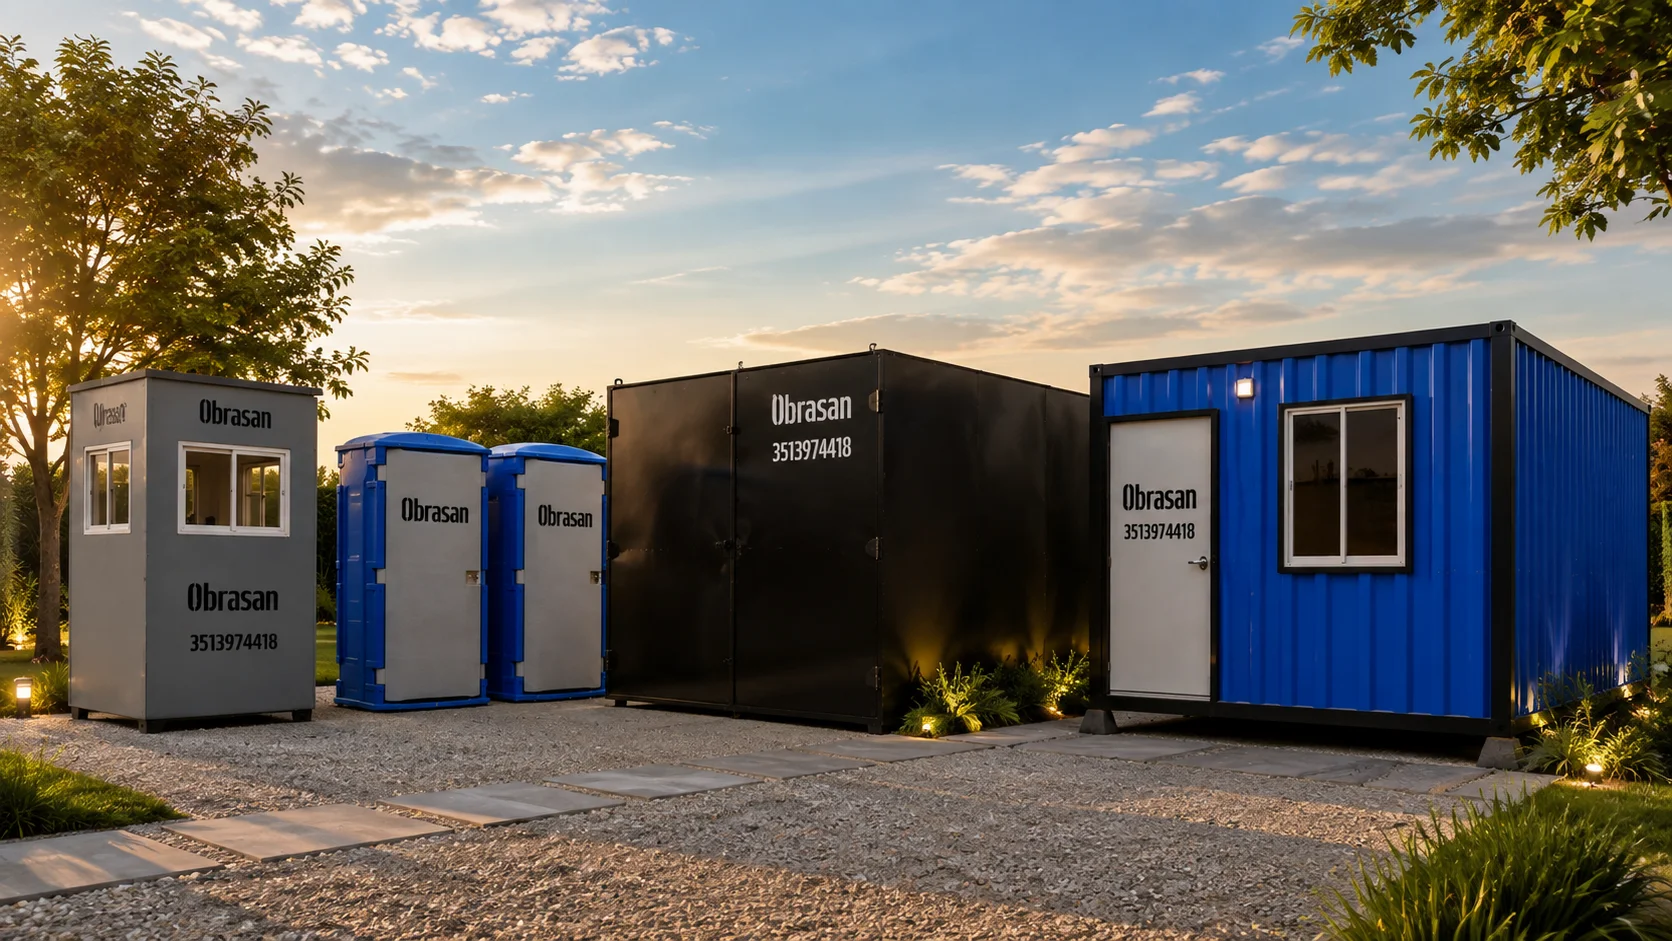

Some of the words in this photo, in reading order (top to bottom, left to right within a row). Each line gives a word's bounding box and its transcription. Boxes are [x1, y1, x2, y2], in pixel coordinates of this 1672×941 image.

[199, 398, 272, 429] Obrasan
[771, 393, 852, 426] Obrasan
[772, 436, 852, 462] 3513974418
[401, 497, 469, 524] Obrasan
[1122, 483, 1197, 511] Obrasan
[538, 504, 593, 528] Obrasan
[1123, 522, 1195, 540] 3513974418
[187, 582, 279, 612] Obrasan
[189, 633, 278, 652] 3513974418
